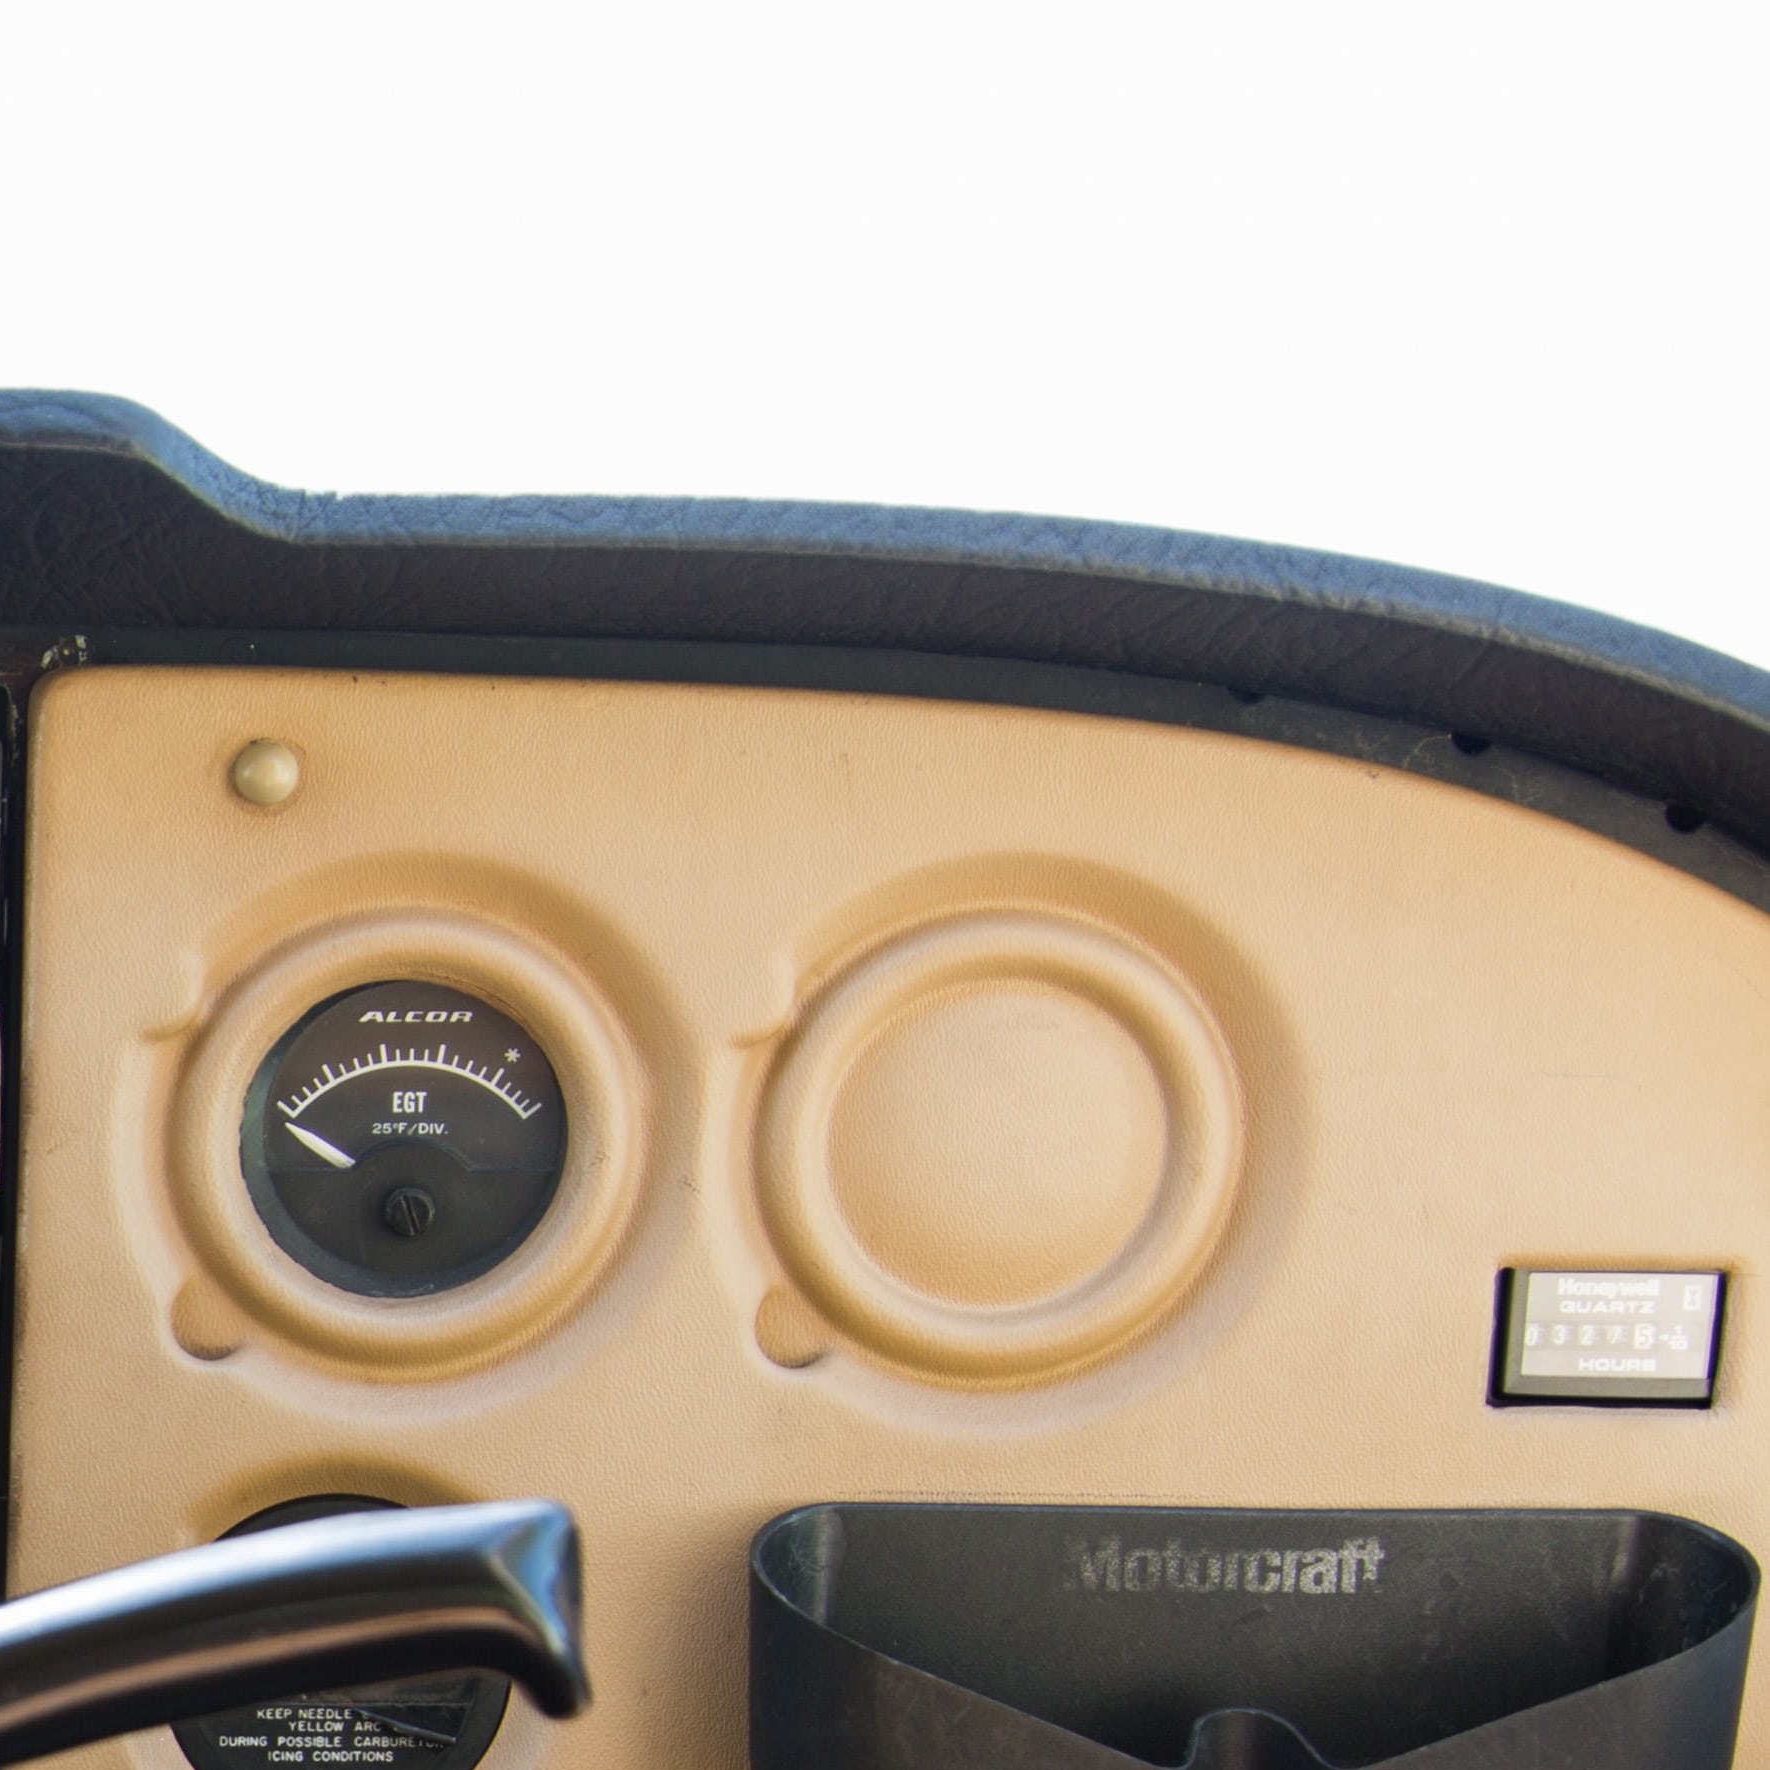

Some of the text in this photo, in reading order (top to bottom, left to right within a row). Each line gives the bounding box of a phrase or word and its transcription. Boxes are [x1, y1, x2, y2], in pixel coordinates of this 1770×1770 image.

[359, 1011, 472, 1022] ALCOR
[392, 1092, 427, 1112] EGT
[1064, 1536, 1385, 1594] Motorcraft
[257, 1709, 352, 1719] KEEP NEEDLE
[289, 1721, 381, 1732] YELLOW ARC
[220, 1736, 342, 1747] DURING POSSIBLE
[269, 1751, 393, 1762] ICING CONDITIONS
